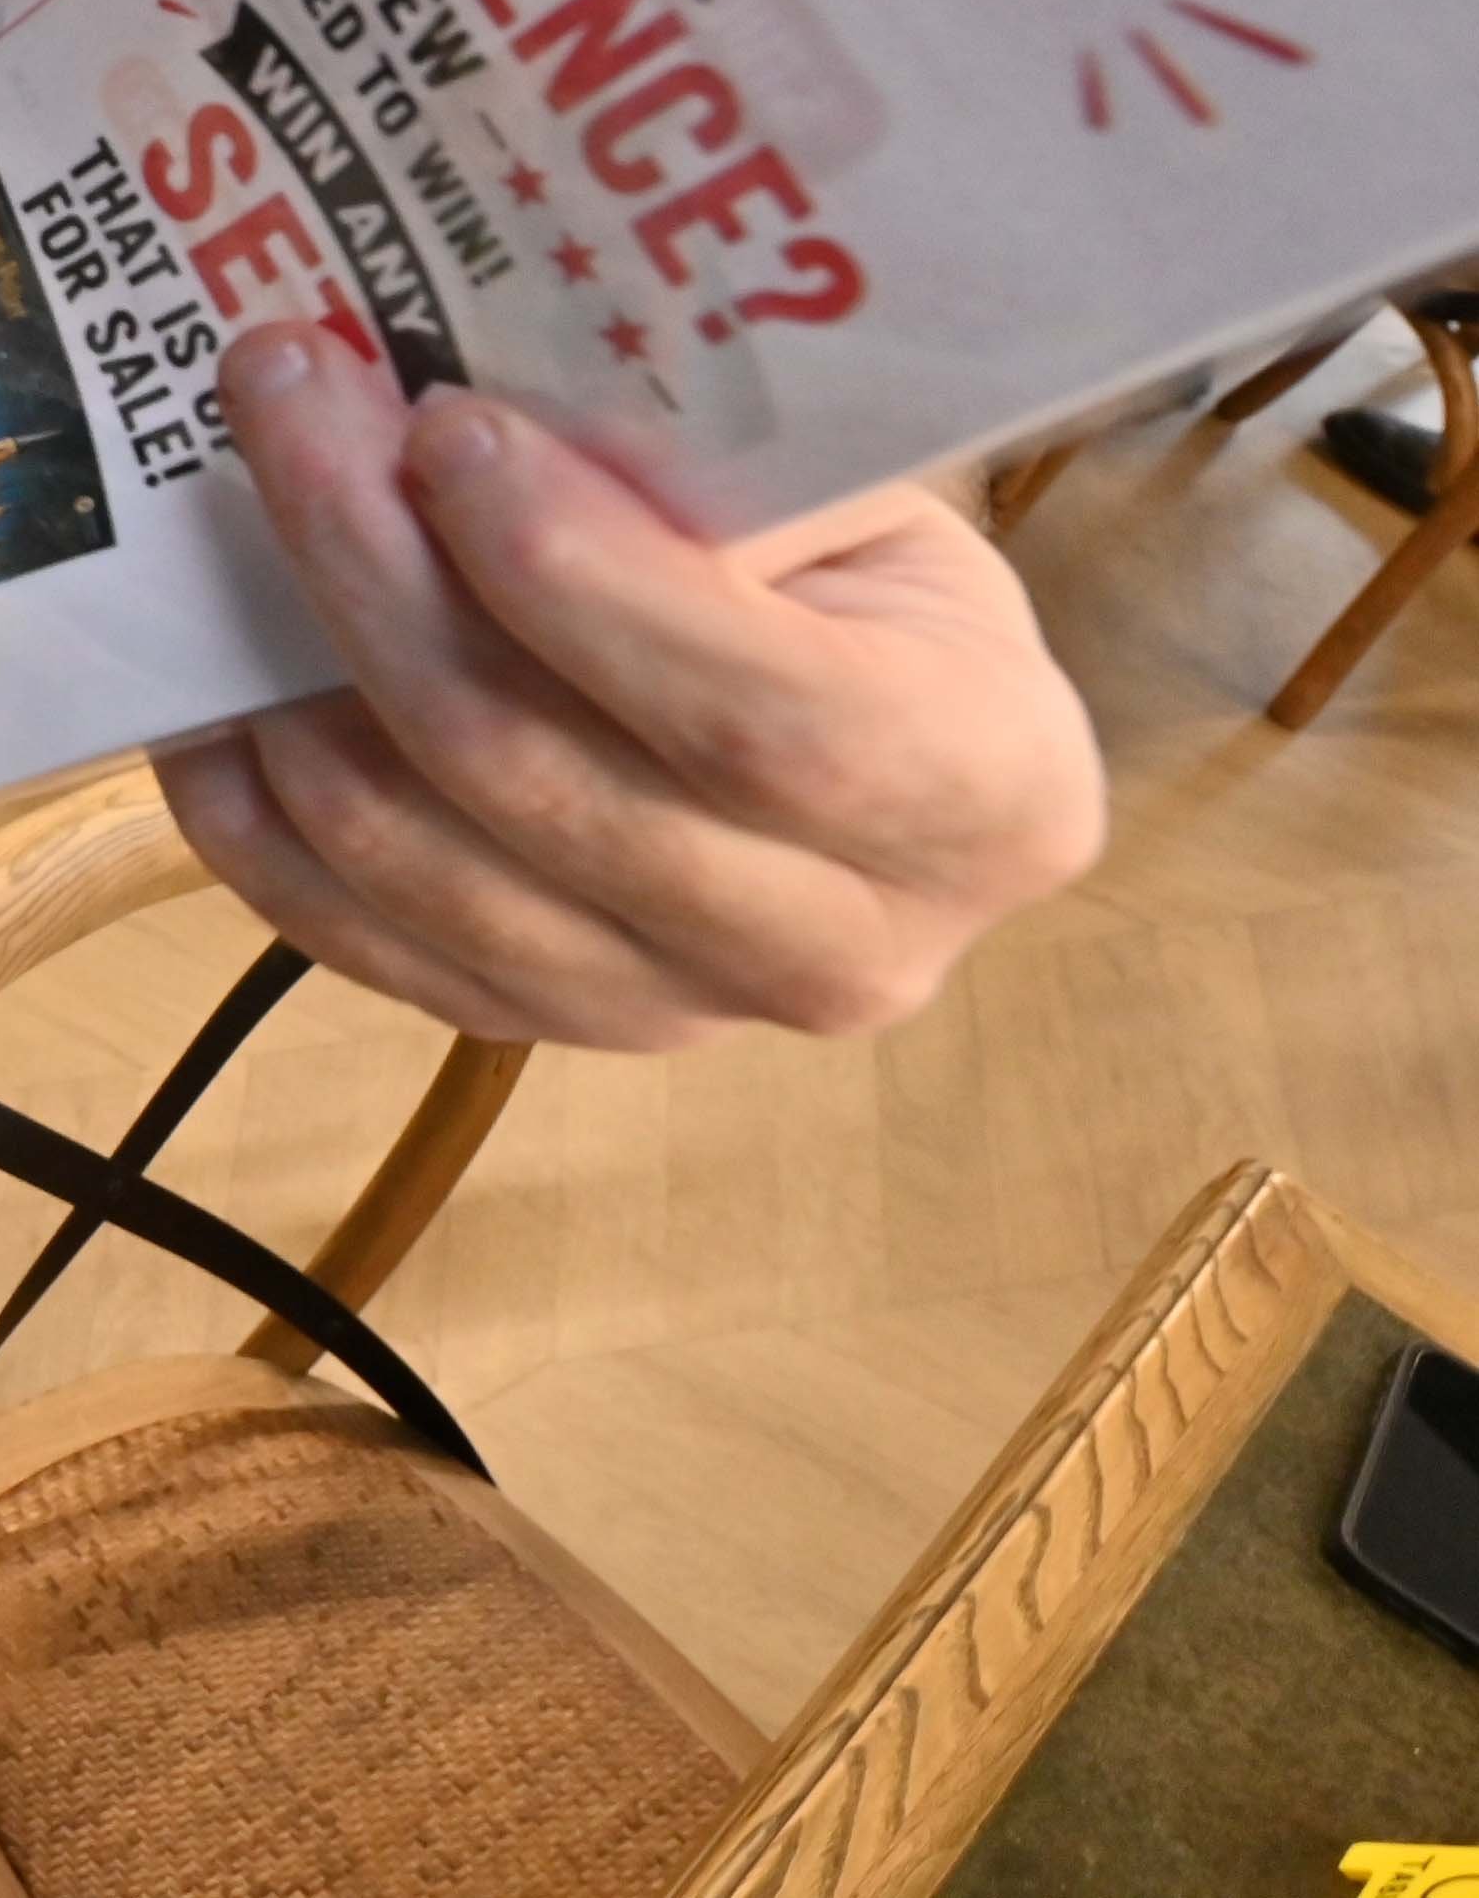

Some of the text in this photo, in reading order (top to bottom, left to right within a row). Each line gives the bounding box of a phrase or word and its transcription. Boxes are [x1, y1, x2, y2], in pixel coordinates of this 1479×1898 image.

[68, 134, 182, 288] THAT
[149, 297, 219, 370] IS
[248, 42, 445, 344] WIN ANY
[354, 51, 424, 139] TO
[407, 137, 517, 290] WIN!
[20, 179, 205, 489] FOR SALE!
